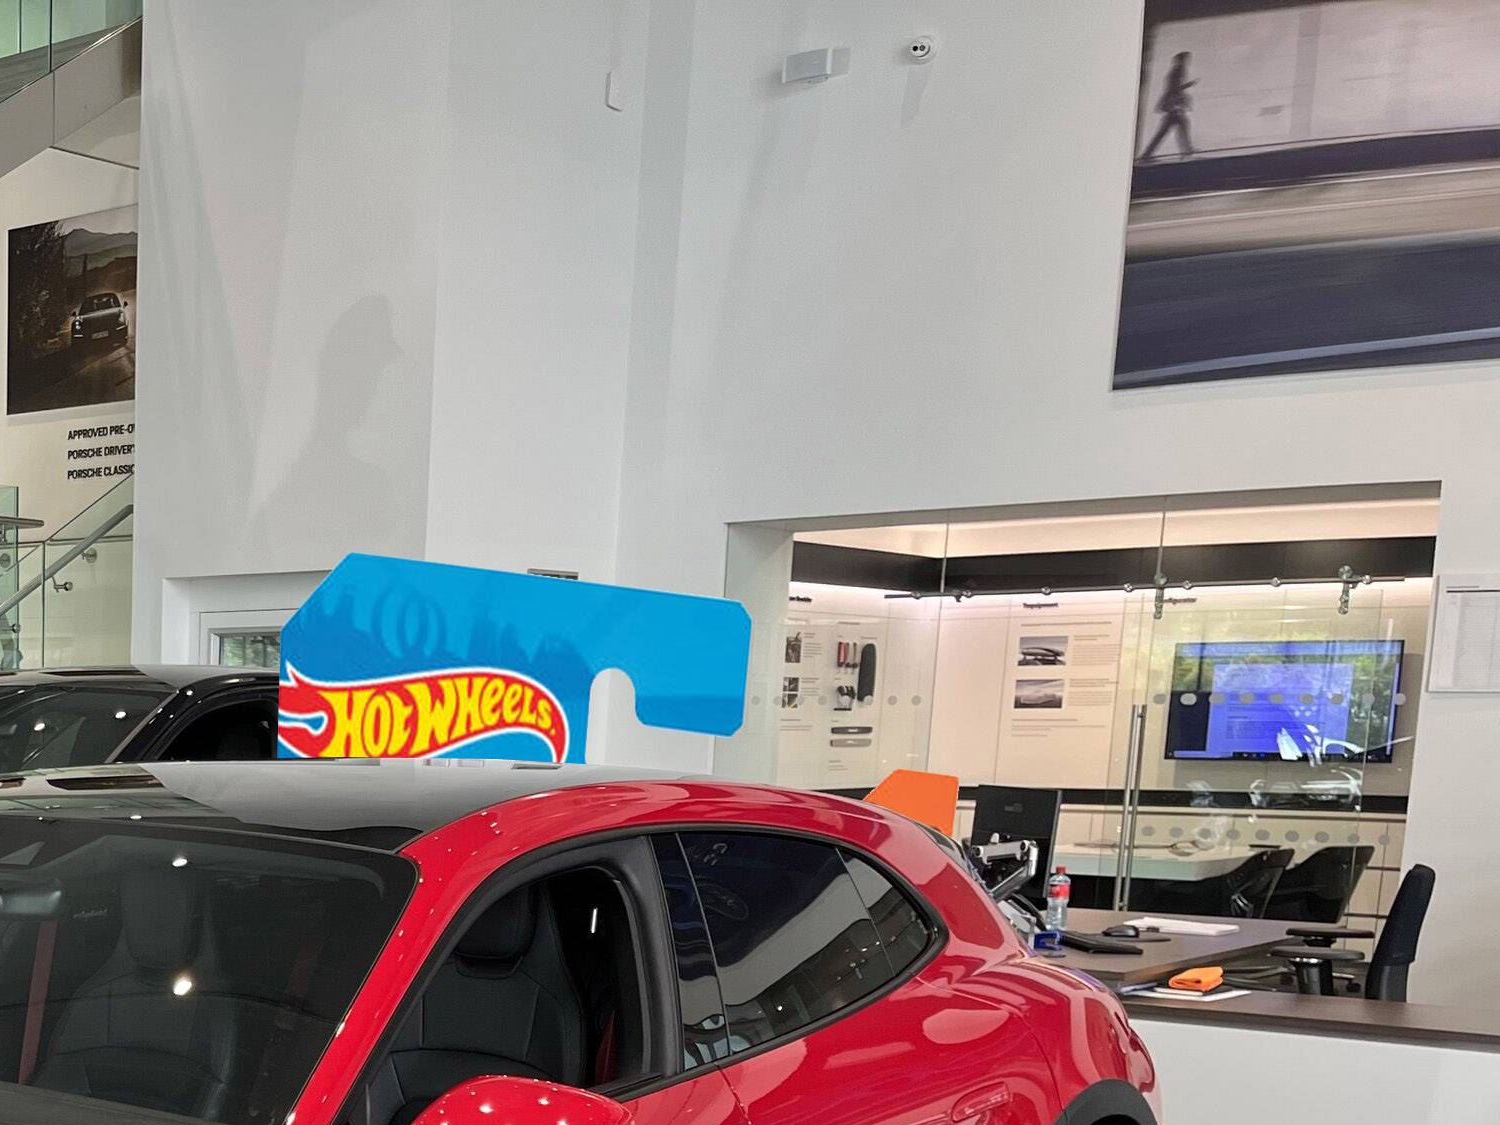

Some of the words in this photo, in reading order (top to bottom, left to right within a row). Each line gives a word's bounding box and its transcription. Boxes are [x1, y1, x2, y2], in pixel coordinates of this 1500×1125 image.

[68, 427, 108, 440] APPROVED
[109, 423, 136, 436] PRE-O
[67, 447, 103, 460] PORSCHE
[67, 467, 103, 480] PORSCHE
